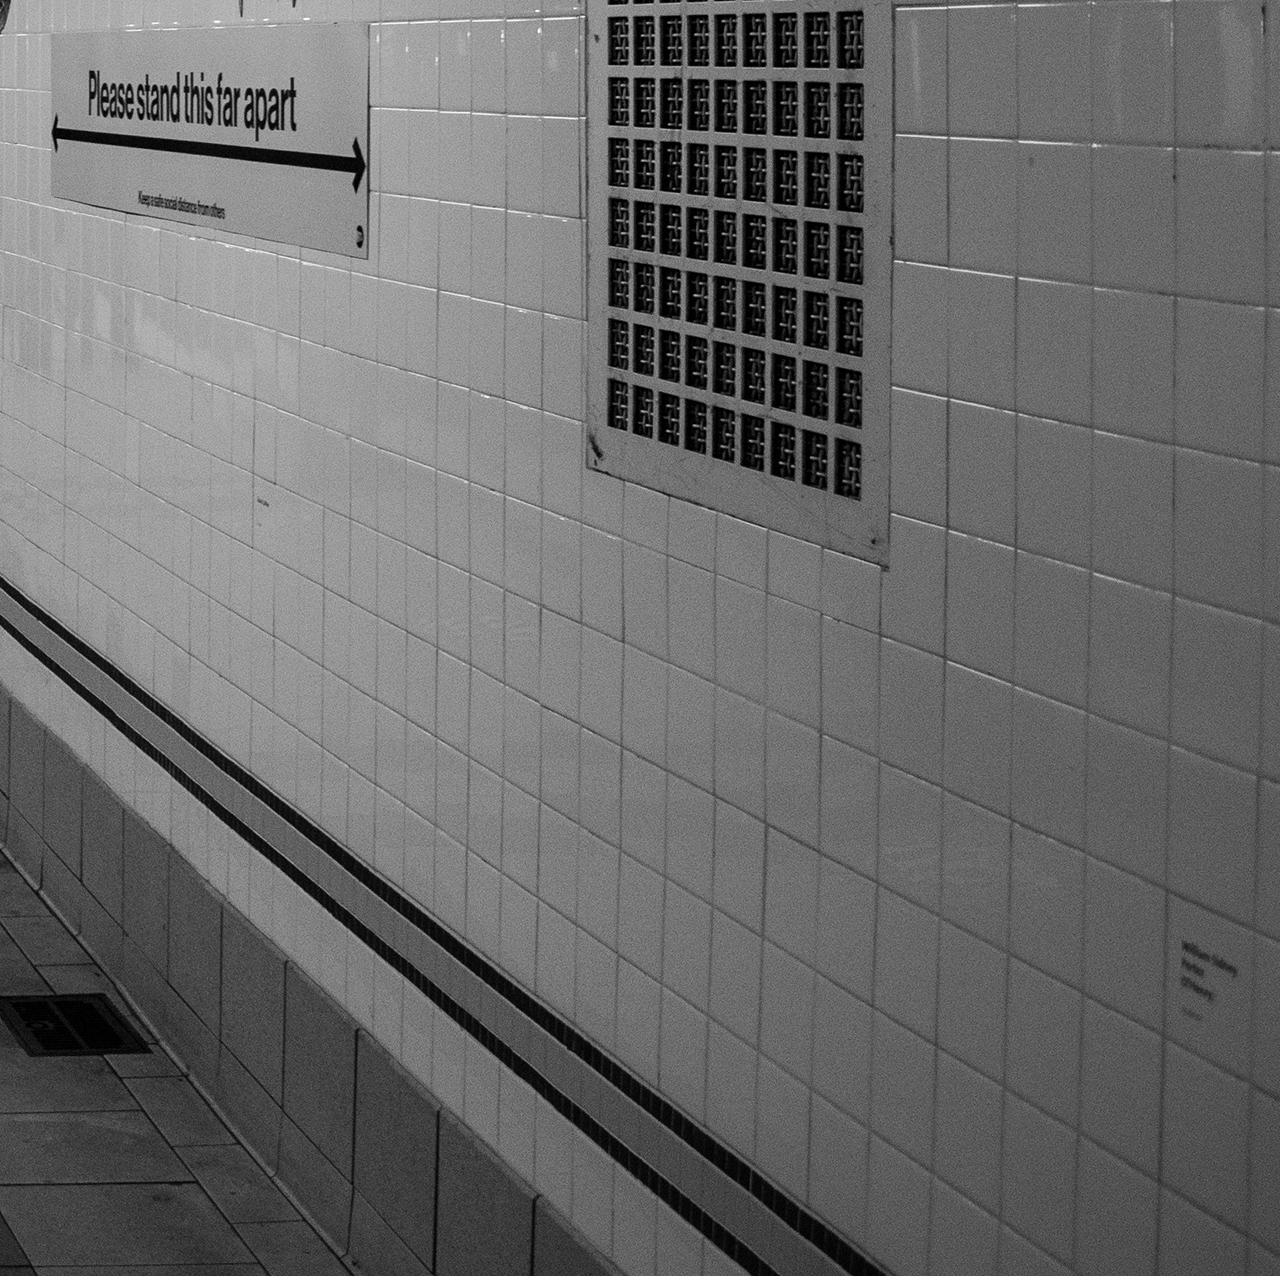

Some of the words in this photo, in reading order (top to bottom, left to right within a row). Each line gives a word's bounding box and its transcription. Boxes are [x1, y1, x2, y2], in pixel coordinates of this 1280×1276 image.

[88, 70, 134, 119] Please
[136, 71, 181, 124] stand
[183, 72, 214, 127] this
[216, 72, 241, 128] far
[243, 76, 298, 142] apart
